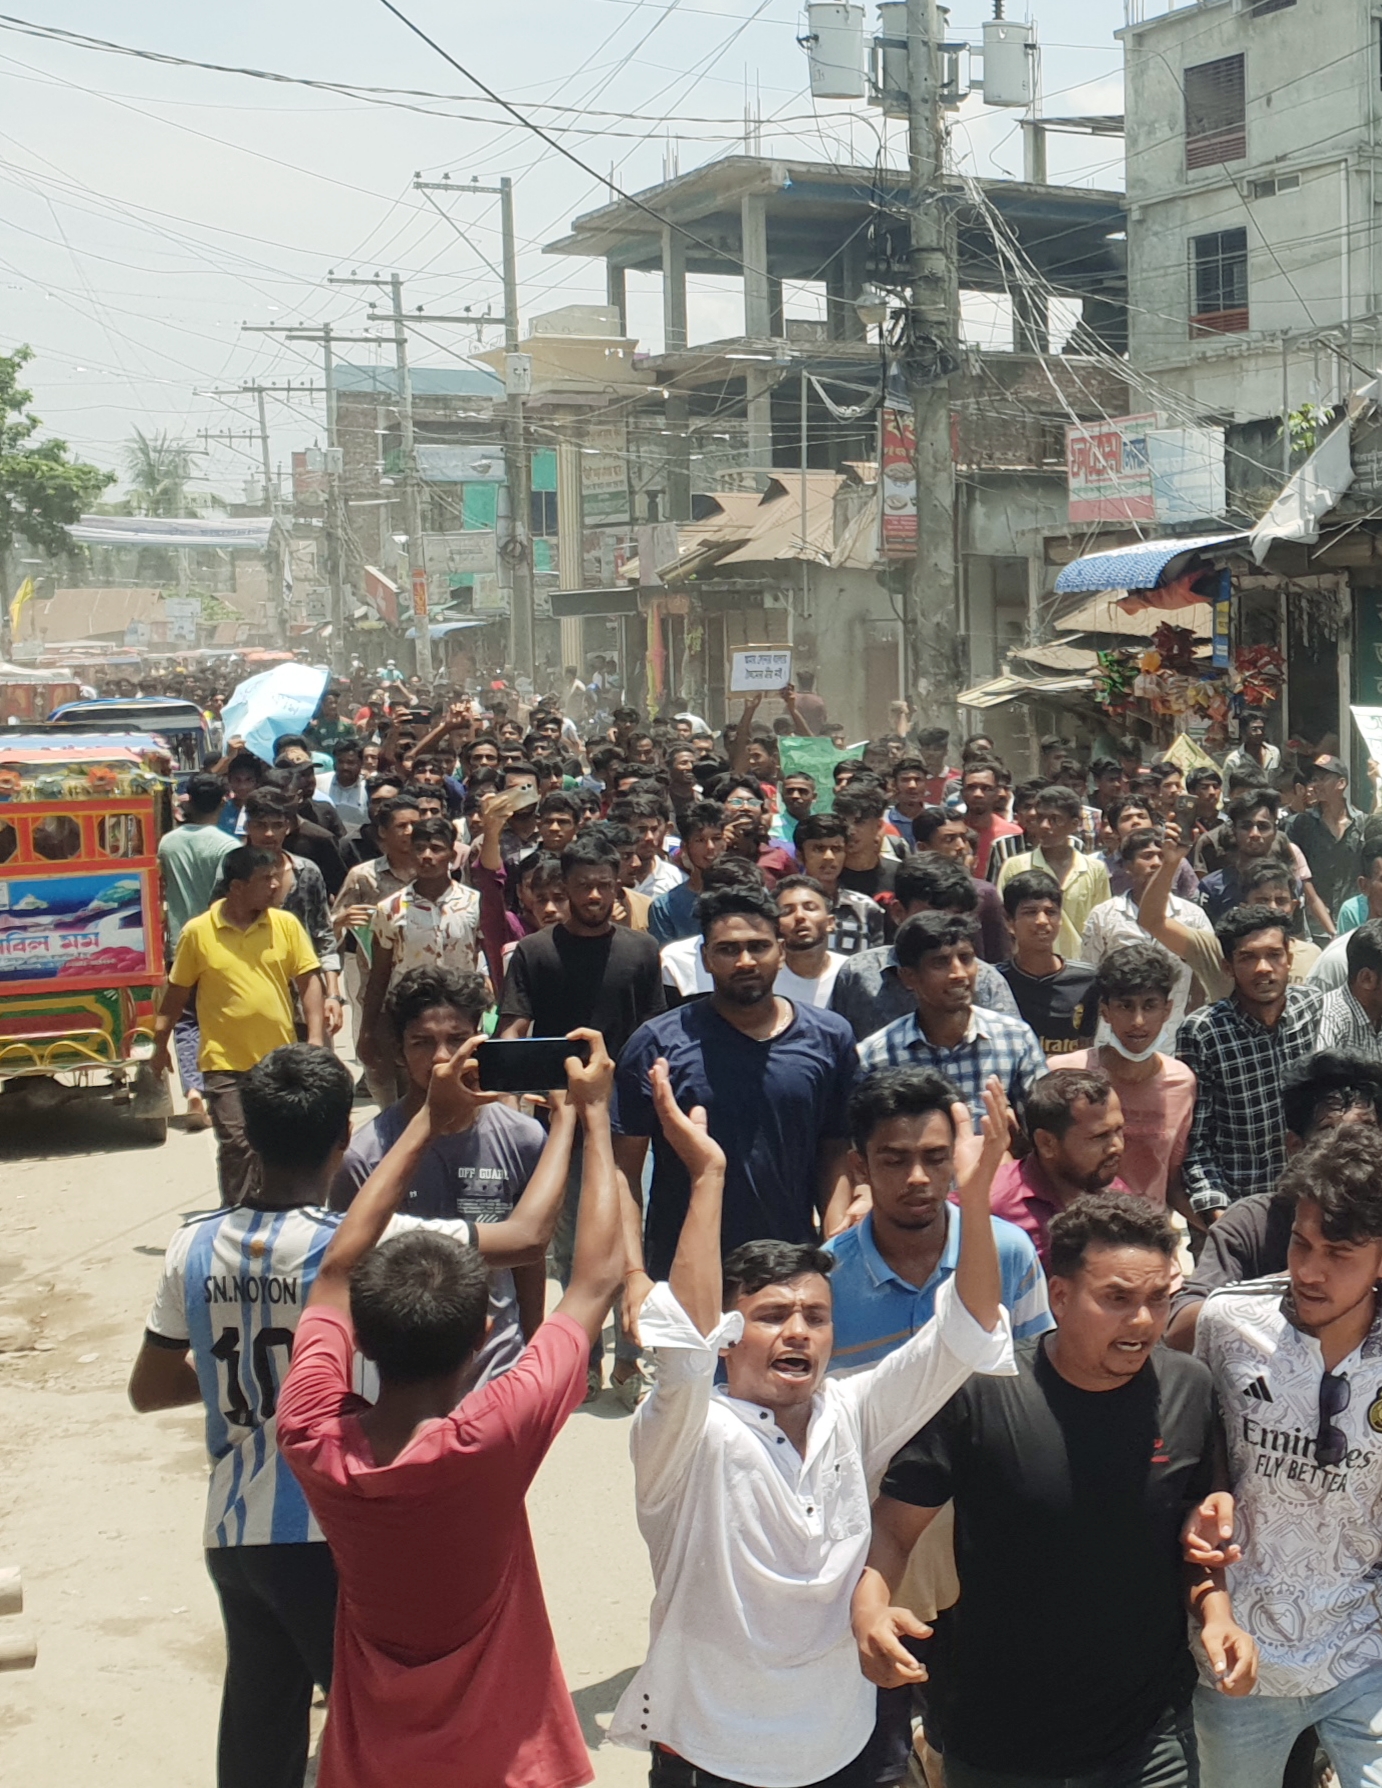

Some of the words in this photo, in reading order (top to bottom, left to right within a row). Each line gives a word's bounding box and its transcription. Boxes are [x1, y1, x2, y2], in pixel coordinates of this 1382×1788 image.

[59, 932, 100, 952] মম
[458, 1167, 476, 1179] OFF
[203, 1275, 298, 1306] SN.NOYON
[210, 1326, 294, 1427] 10
[1243, 1416, 1376, 1469] Emires
[1255, 1453, 1282, 1478] FLY
[1288, 1461, 1347, 1493] BETTER
